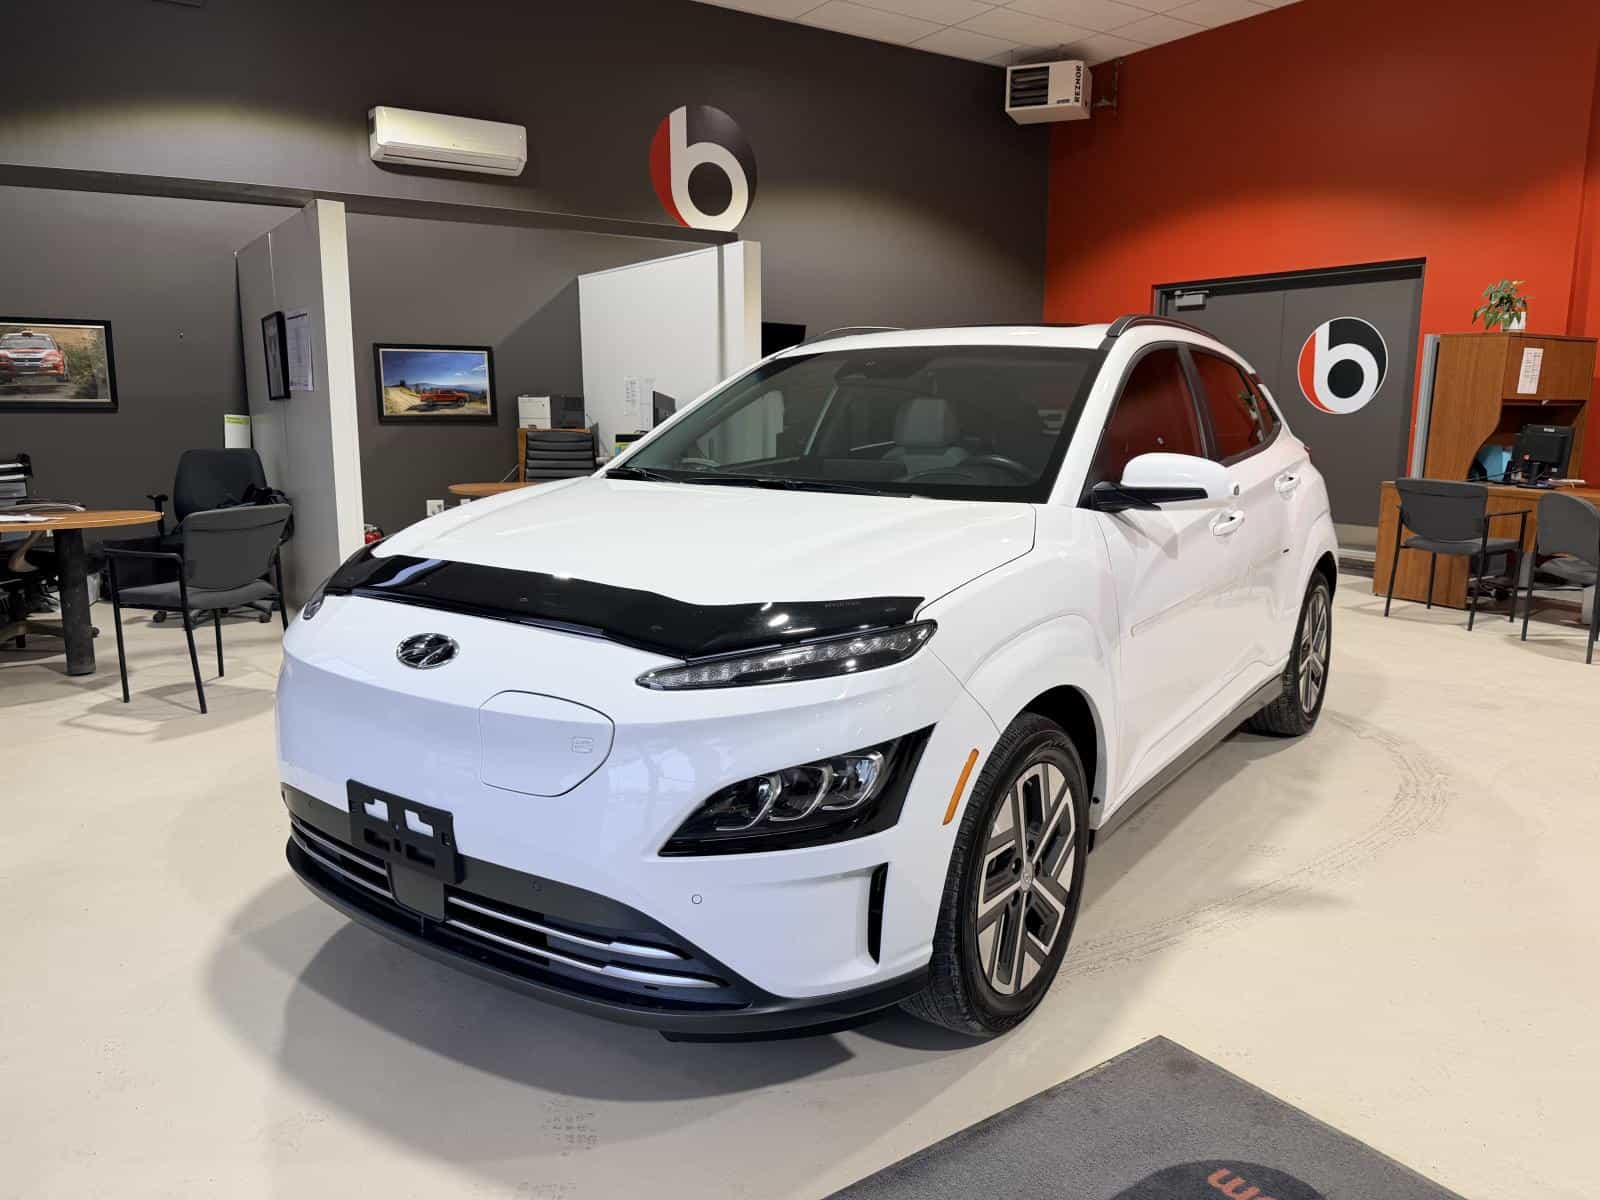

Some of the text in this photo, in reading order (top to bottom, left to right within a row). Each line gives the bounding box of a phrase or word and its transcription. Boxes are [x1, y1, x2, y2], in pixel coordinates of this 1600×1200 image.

[1073, 65, 1082, 103] REZNOR
[669, 104, 748, 232] b
[1313, 319, 1379, 414] b
